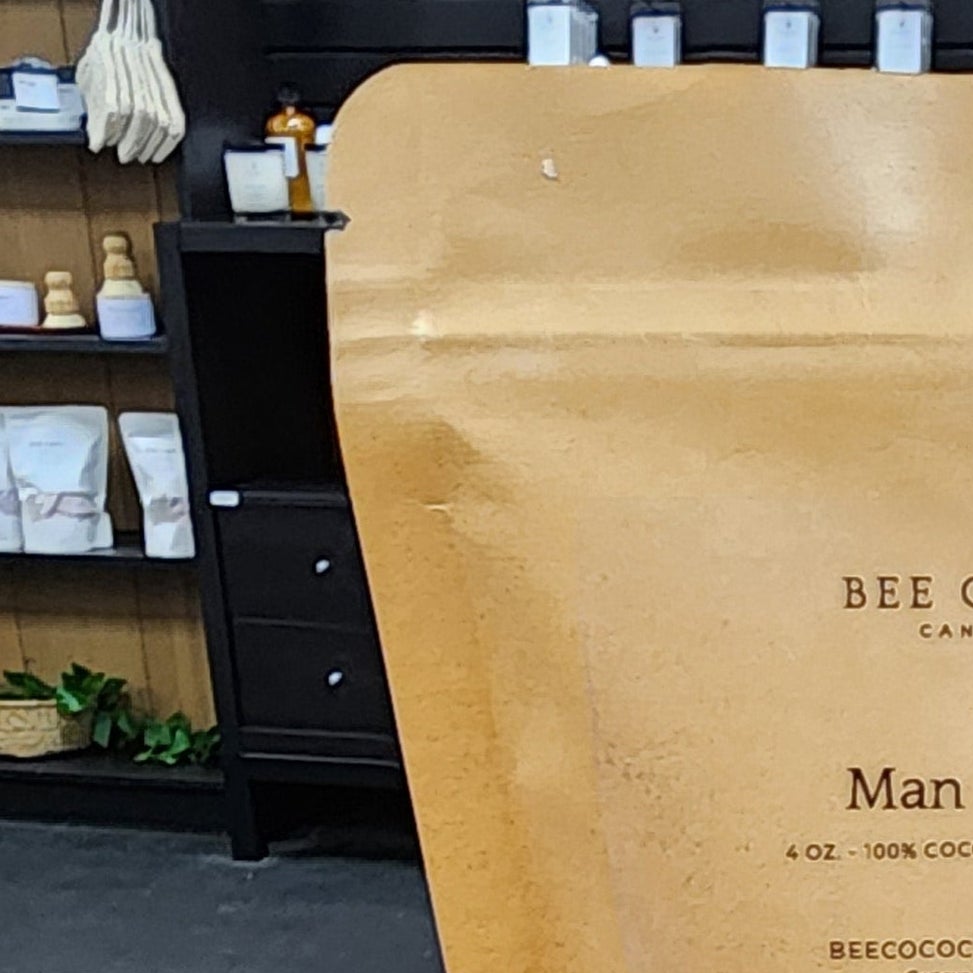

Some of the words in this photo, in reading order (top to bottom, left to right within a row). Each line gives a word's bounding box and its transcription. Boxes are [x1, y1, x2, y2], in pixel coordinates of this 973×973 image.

[843, 576, 933, 609] BEE
[846, 767, 965, 810] Man
[785, 844, 799, 861] 4
[863, 843, 917, 860] 100%
